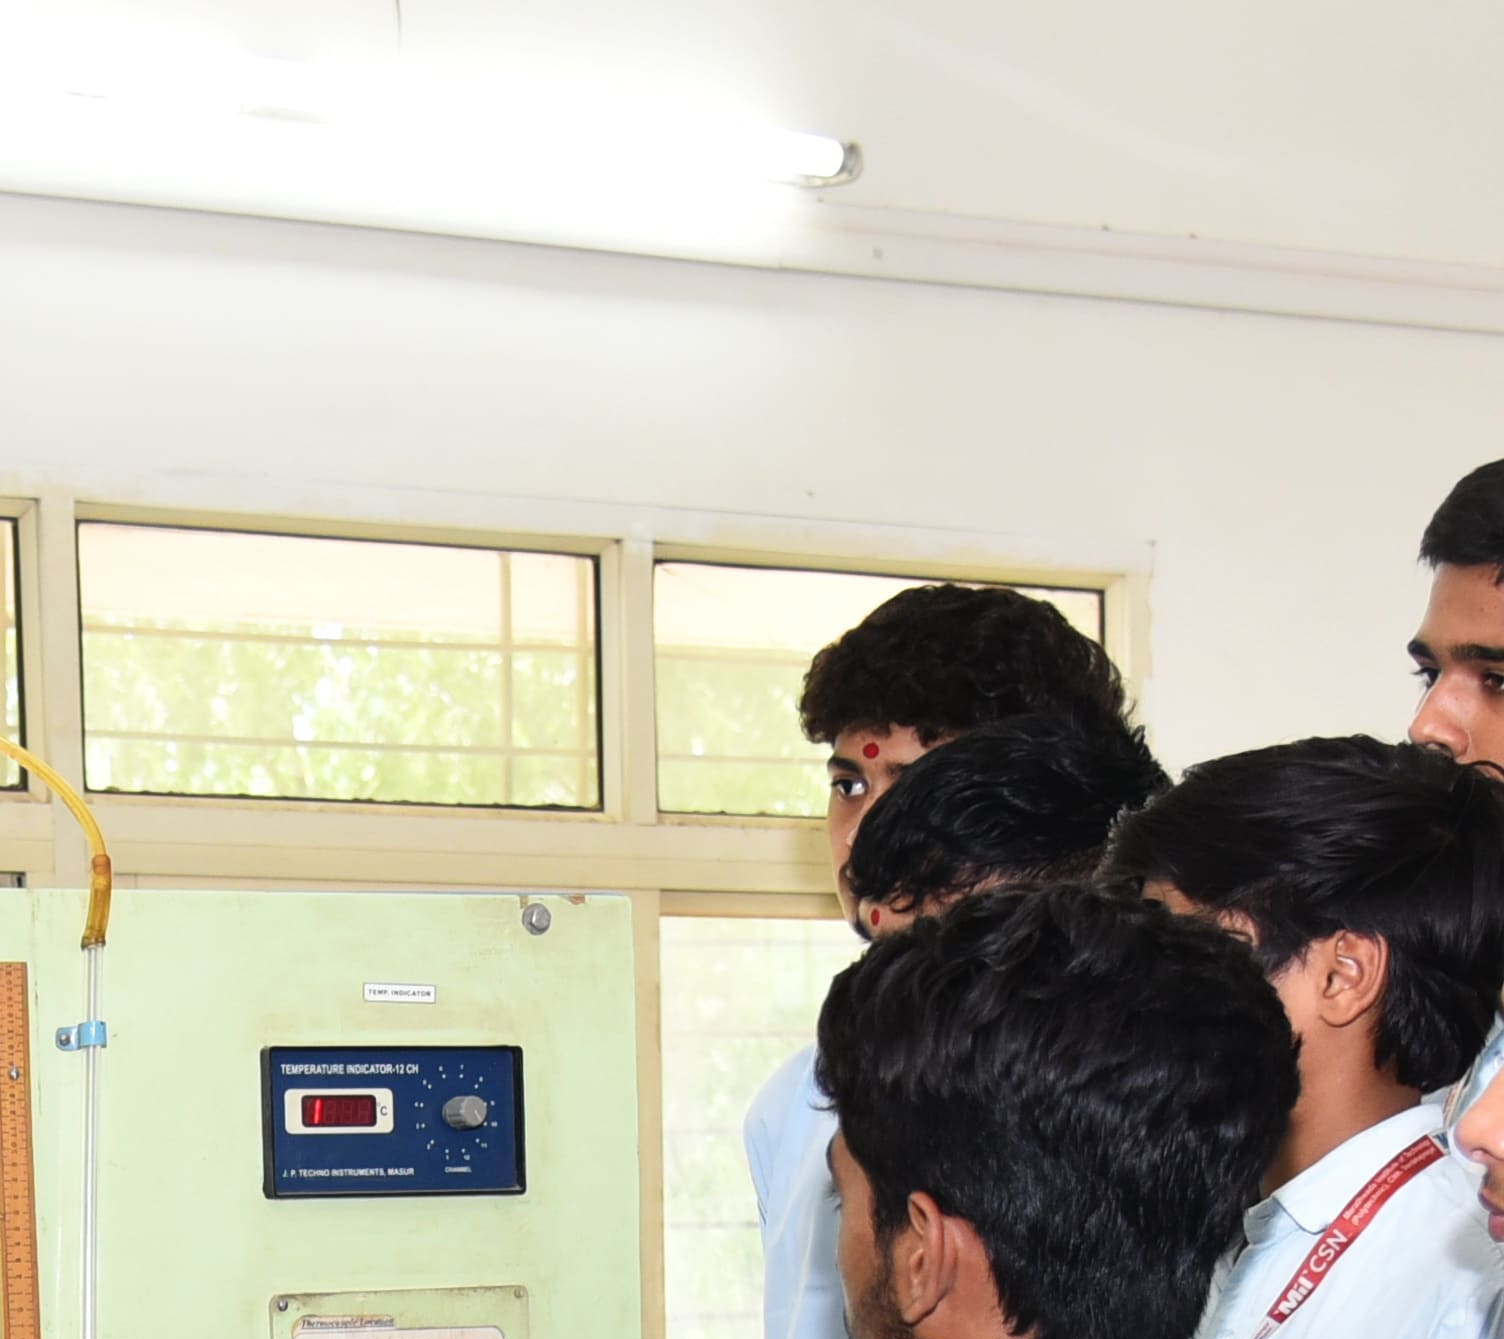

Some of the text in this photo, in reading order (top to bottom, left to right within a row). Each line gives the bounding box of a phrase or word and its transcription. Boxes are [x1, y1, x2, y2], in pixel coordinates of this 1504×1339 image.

[391, 989, 432, 998] INDICATOR
[280, 1064, 419, 1075] TEMPERATURE INDICATOR-12 CH
[299, 1168, 330, 1177] TECHNO
[331, 1168, 386, 1178] INSTRUMENTS,
[388, 1167, 414, 1176] MASUR
[1309, 1229, 1349, 1273] CSN
